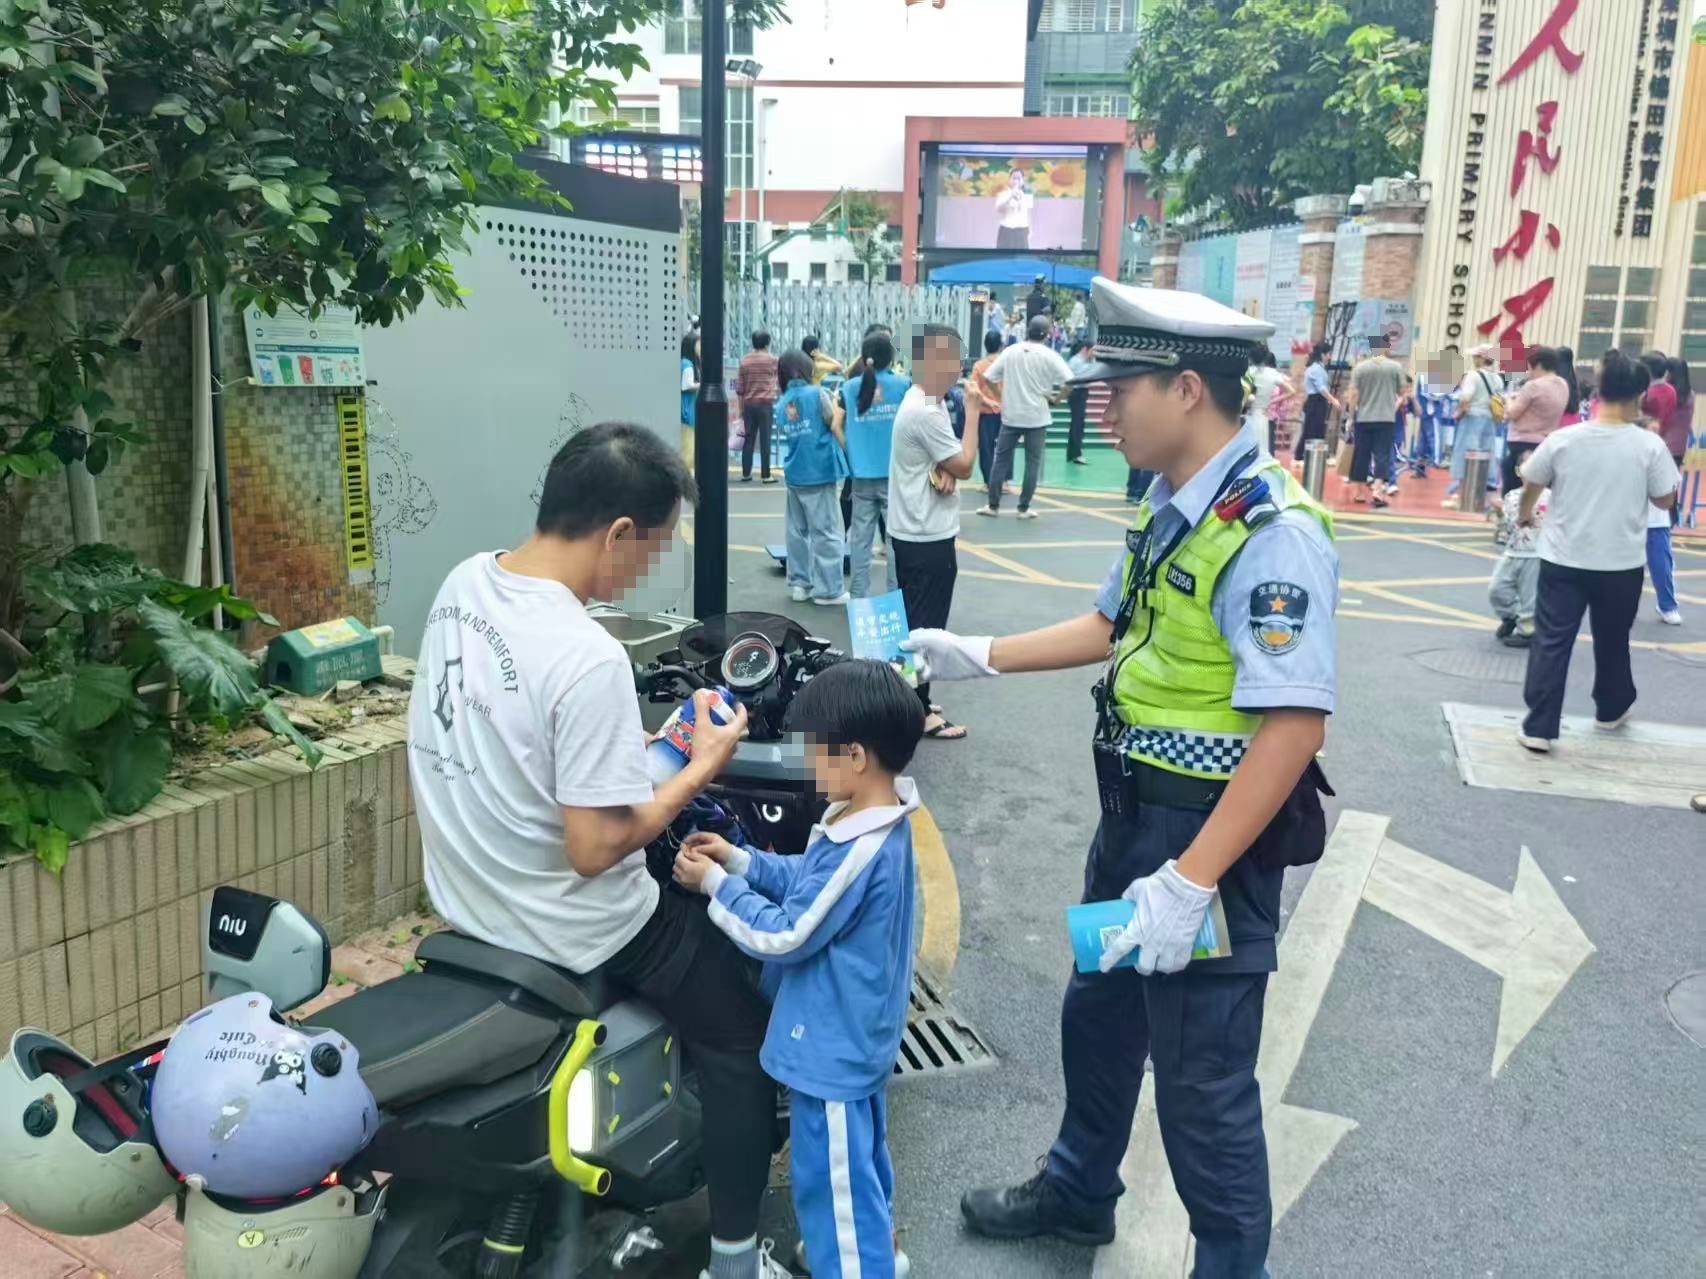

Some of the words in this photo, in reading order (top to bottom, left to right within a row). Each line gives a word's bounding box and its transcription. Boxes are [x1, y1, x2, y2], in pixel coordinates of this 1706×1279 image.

[1457, 112, 1486, 244] PRIMARY
[1224, 483, 1252, 504] POLICE
[459, 612, 487, 633] AND
[484, 625, 519, 694] REMFORT
[205, 1047, 268, 1067] Naughty
